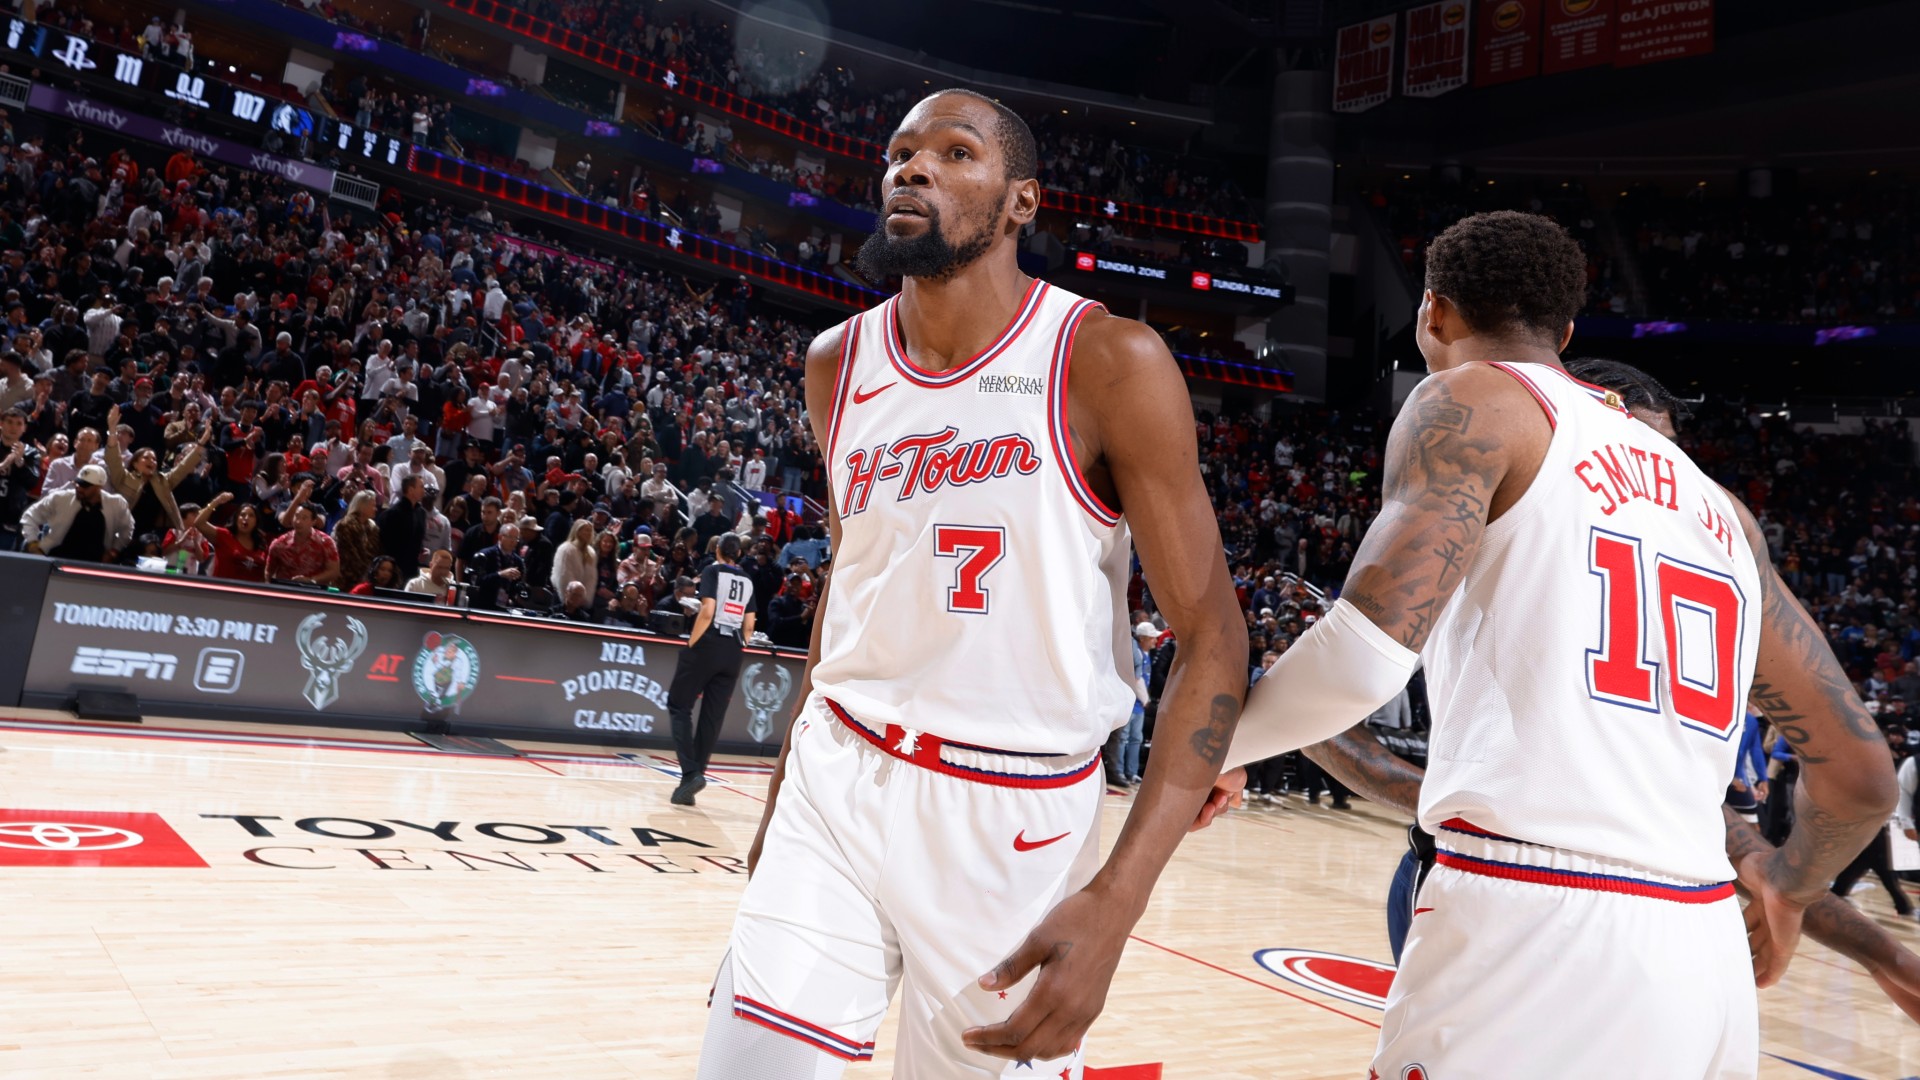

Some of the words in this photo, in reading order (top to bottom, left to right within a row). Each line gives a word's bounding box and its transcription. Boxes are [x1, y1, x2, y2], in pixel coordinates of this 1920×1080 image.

[1620, 0, 1710, 23] OLAJUWON
[66, 100, 128, 130] xfinity
[232, 90, 266, 123] 107
[161, 127, 219, 156] xfinity
[250, 153, 304, 180] xfinity
[1096, 259, 1136, 275] TUNDRA
[1138, 266, 1167, 280] ZONE
[1212, 278, 1251, 294] TUNDRA
[1253, 286, 1281, 299] ZONE
[978, 382, 1043, 395] HERMANN
[979, 375, 1044, 388] MEMORIAL
[840, 425, 1042, 520] H-Town
[1574, 443, 1679, 516] SMITH
[933, 523, 1006, 615] 7
[728, 578, 745, 602] 81
[53, 602, 173, 634] TOMORROW
[174, 615, 218, 638] 3:30
[222, 620, 254, 643] PM
[254, 624, 279, 644] ET
[1584, 525, 1747, 742] 10
[70, 646, 179, 682] ESPN
[368, 653, 405, 674] AT
[600, 641, 646, 667] NBA
[561, 669, 670, 711] PIONEERS
[573, 708, 655, 735] CLASSIC
[198, 813, 718, 850] TOYOTA
[242, 846, 748, 875] CENTER
